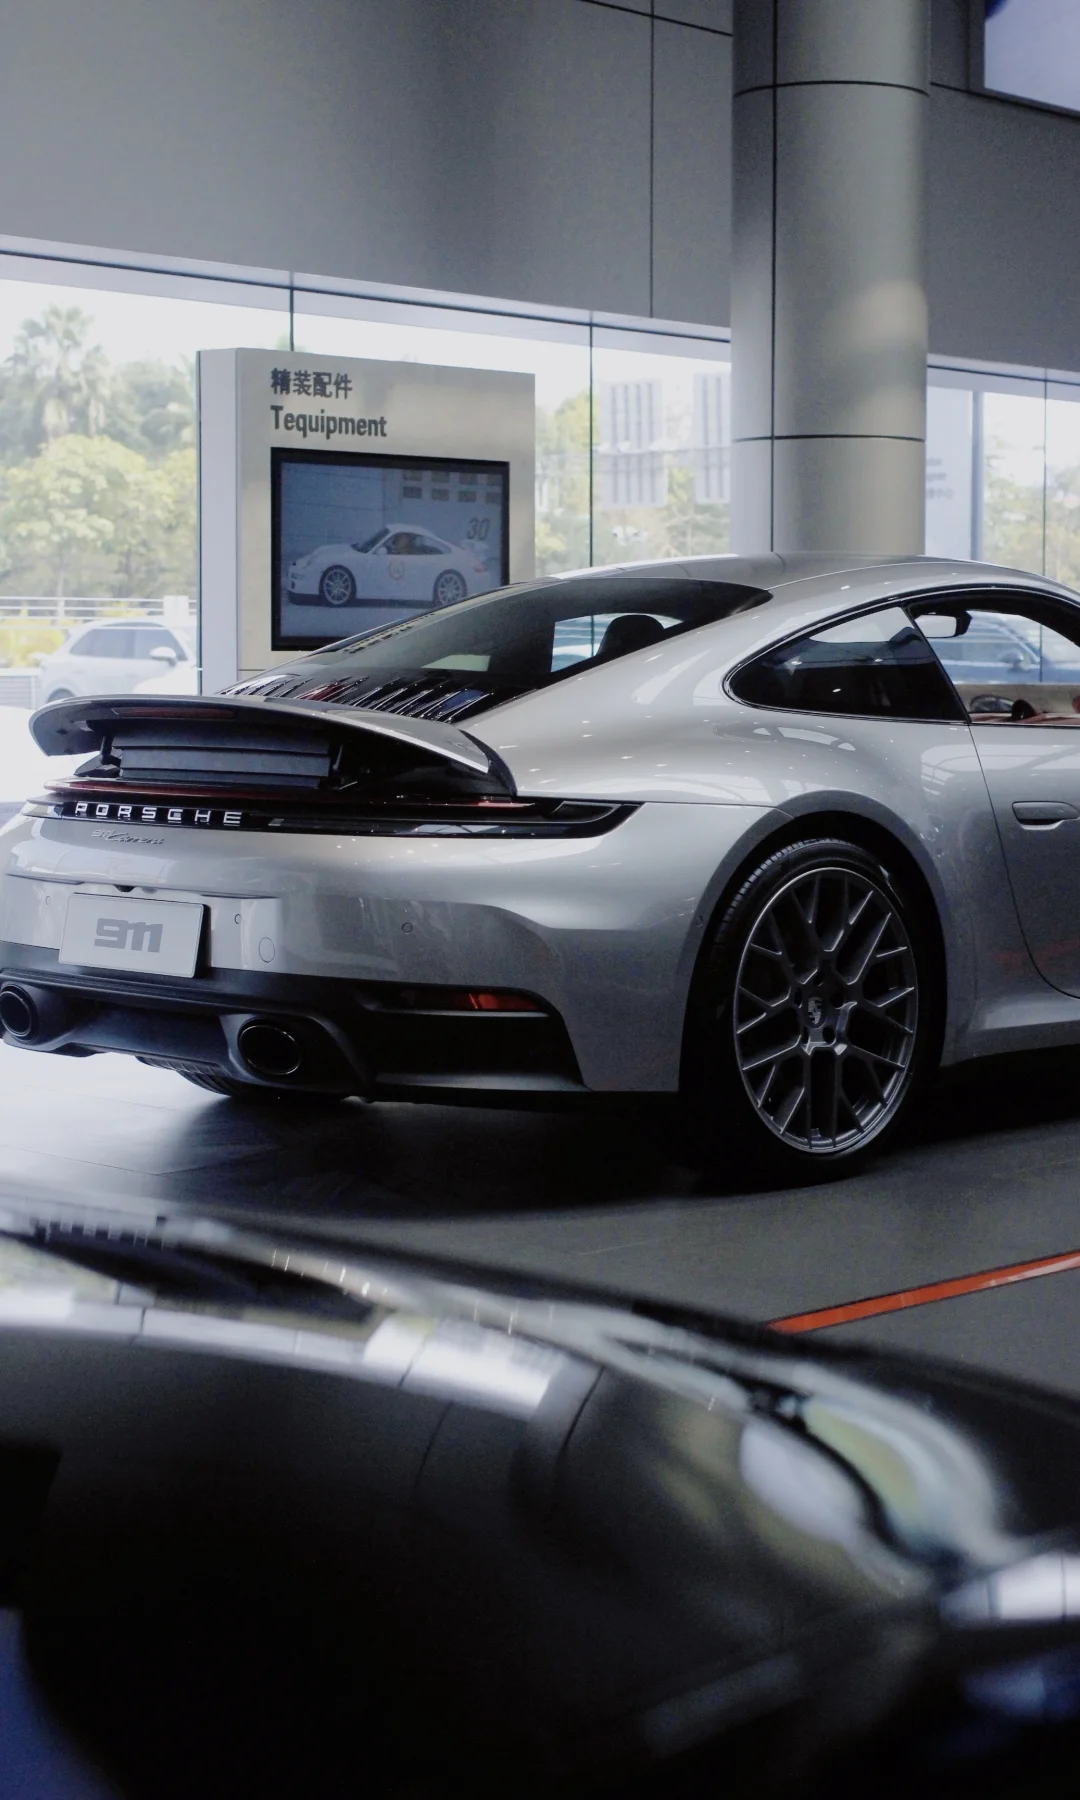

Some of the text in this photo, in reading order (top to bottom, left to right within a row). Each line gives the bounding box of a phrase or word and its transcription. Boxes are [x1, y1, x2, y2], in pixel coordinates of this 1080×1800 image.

[270, 367, 353, 400] 精装配件
[270, 405, 387, 440] Tequipment
[75, 802, 243, 824] PORSCHE
[94, 917, 164, 953] 911
